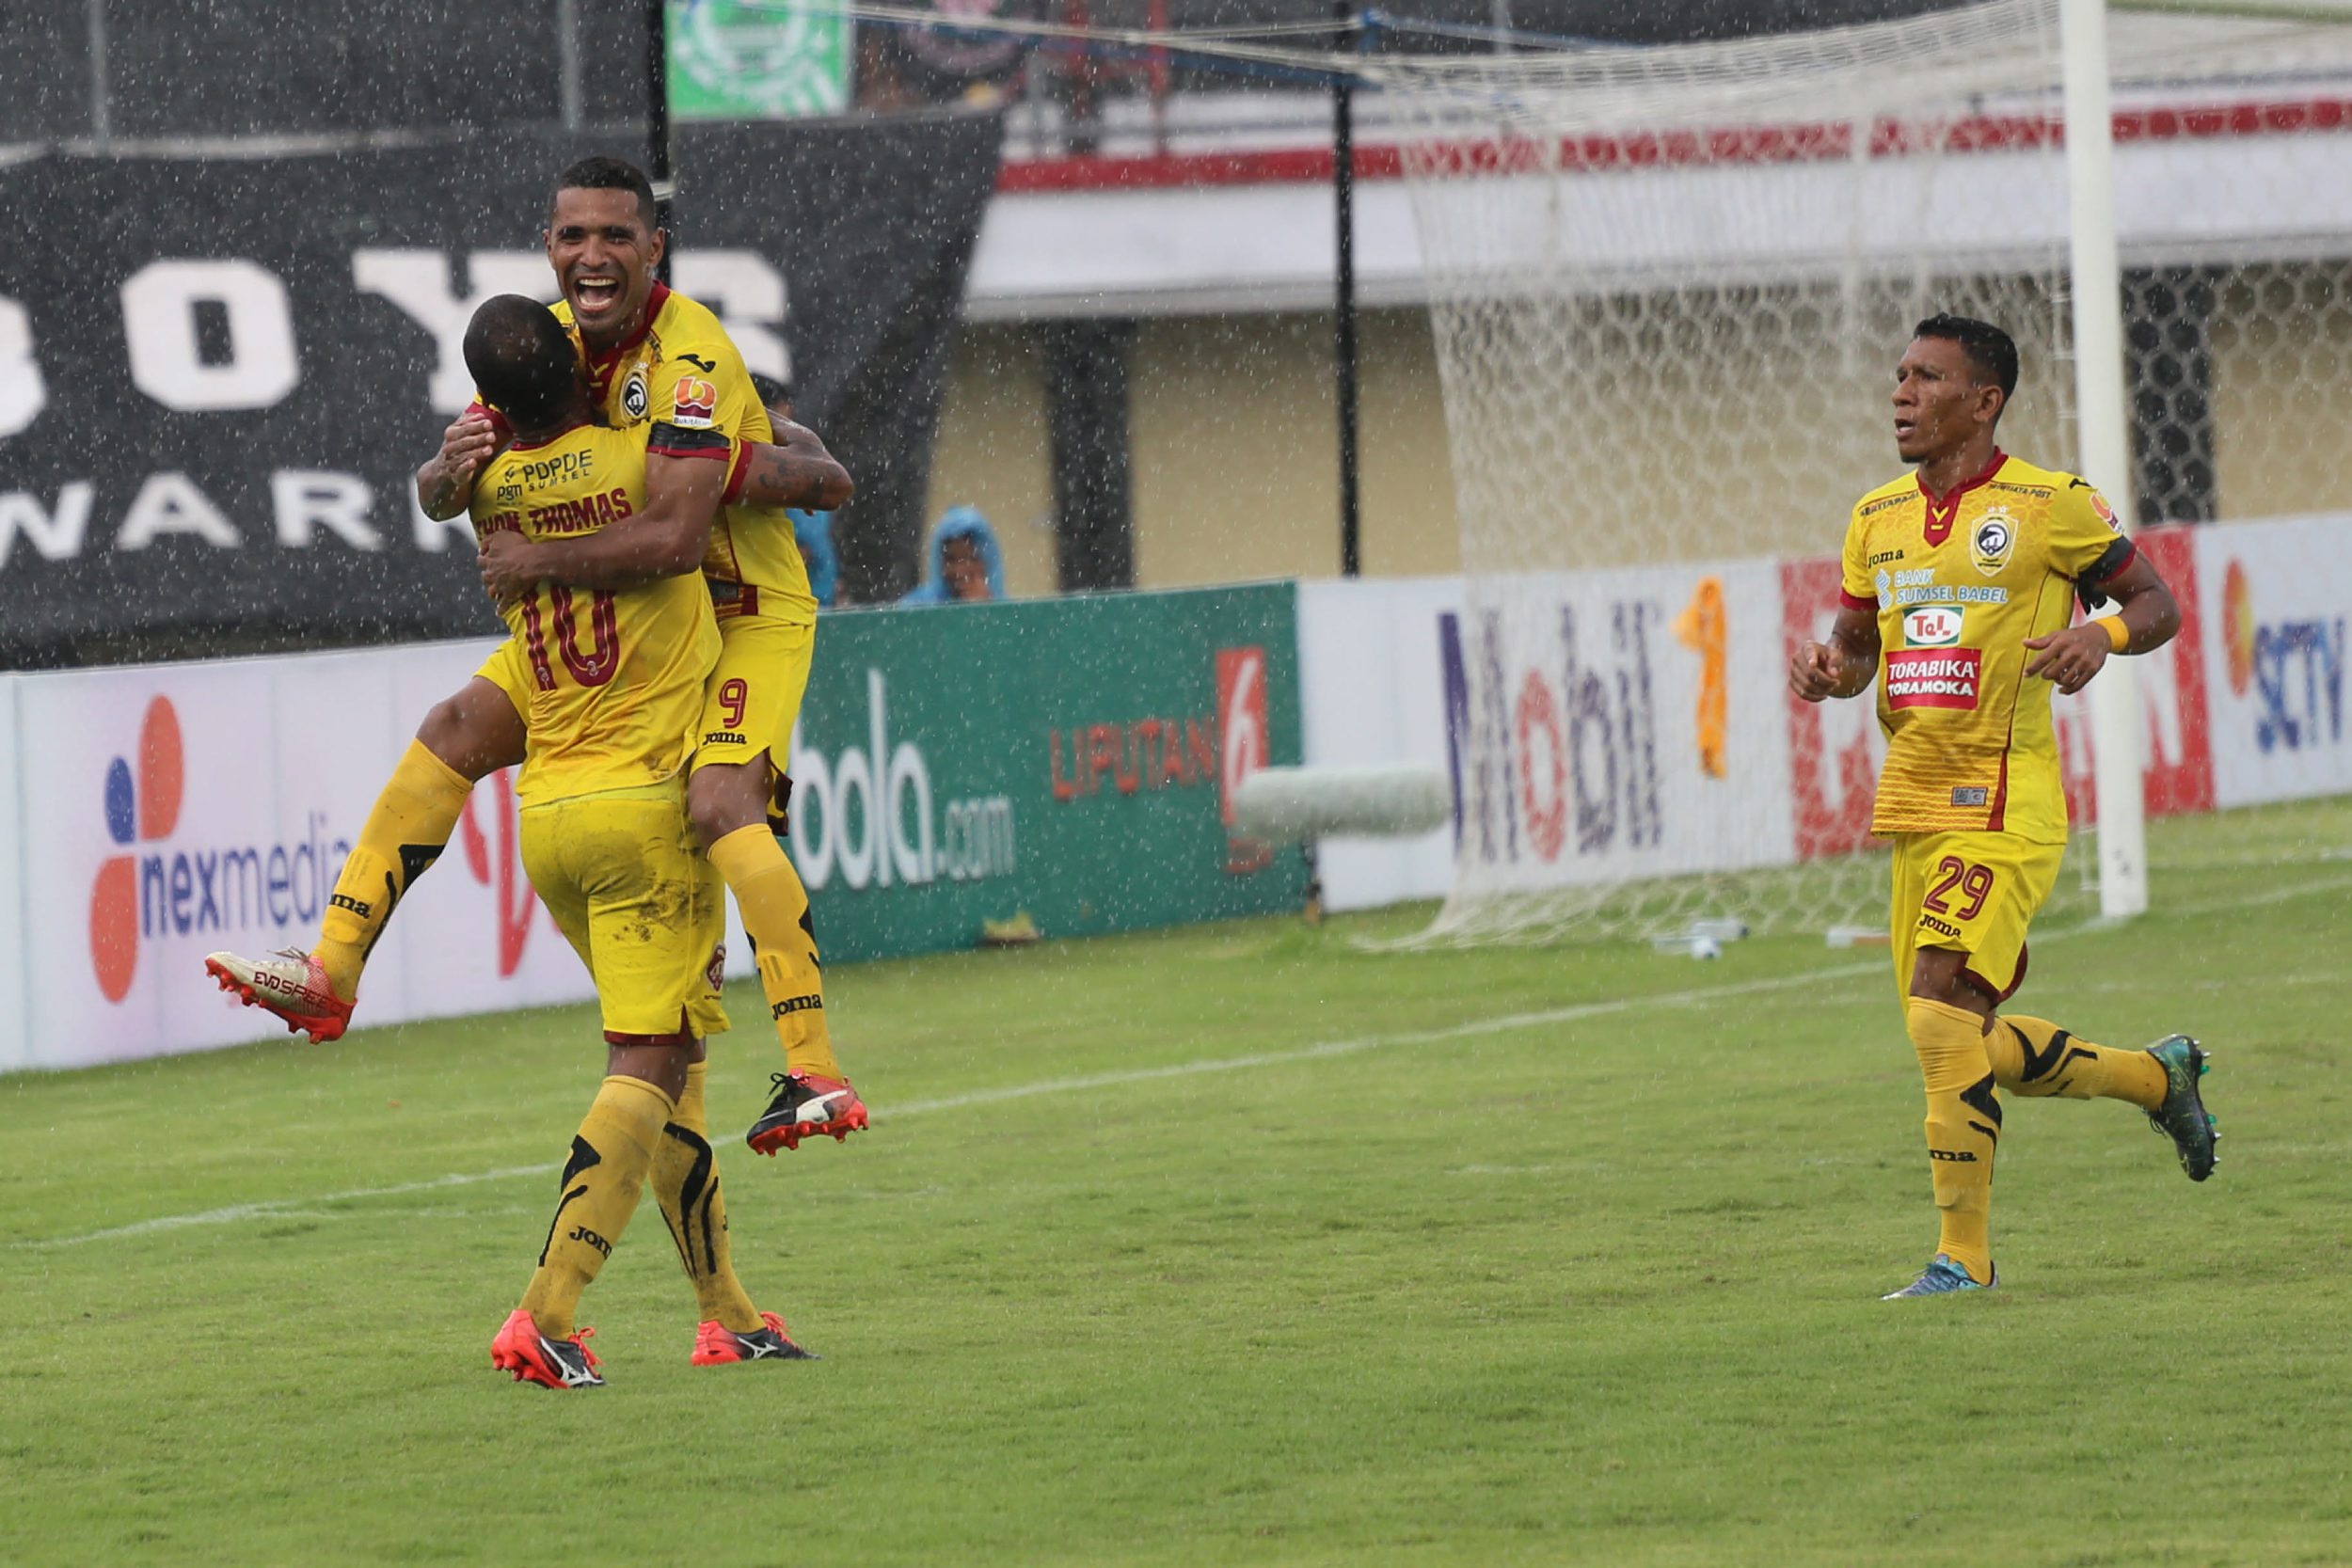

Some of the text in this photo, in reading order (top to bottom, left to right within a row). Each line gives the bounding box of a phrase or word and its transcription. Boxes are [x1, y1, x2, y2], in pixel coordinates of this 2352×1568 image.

[0, 246, 793, 437] OYS
[522, 449, 593, 483] PDPDE
[529, 470, 591, 492] SUMSEL
[497, 483, 523, 501] pgn
[528, 487, 633, 535] THOMAS
[1894, 568, 1936, 587] BANK
[1897, 585, 2009, 605] SUMSEL BABEL
[1889, 659, 1975, 681] TORABIKA
[719, 678, 748, 729] 9
[1887, 680, 1974, 697] TORAMOKA
[1437, 602, 1662, 863] Mobil
[1049, 712, 1221, 801] LIPUTAN
[1923, 855, 1994, 921] 29
